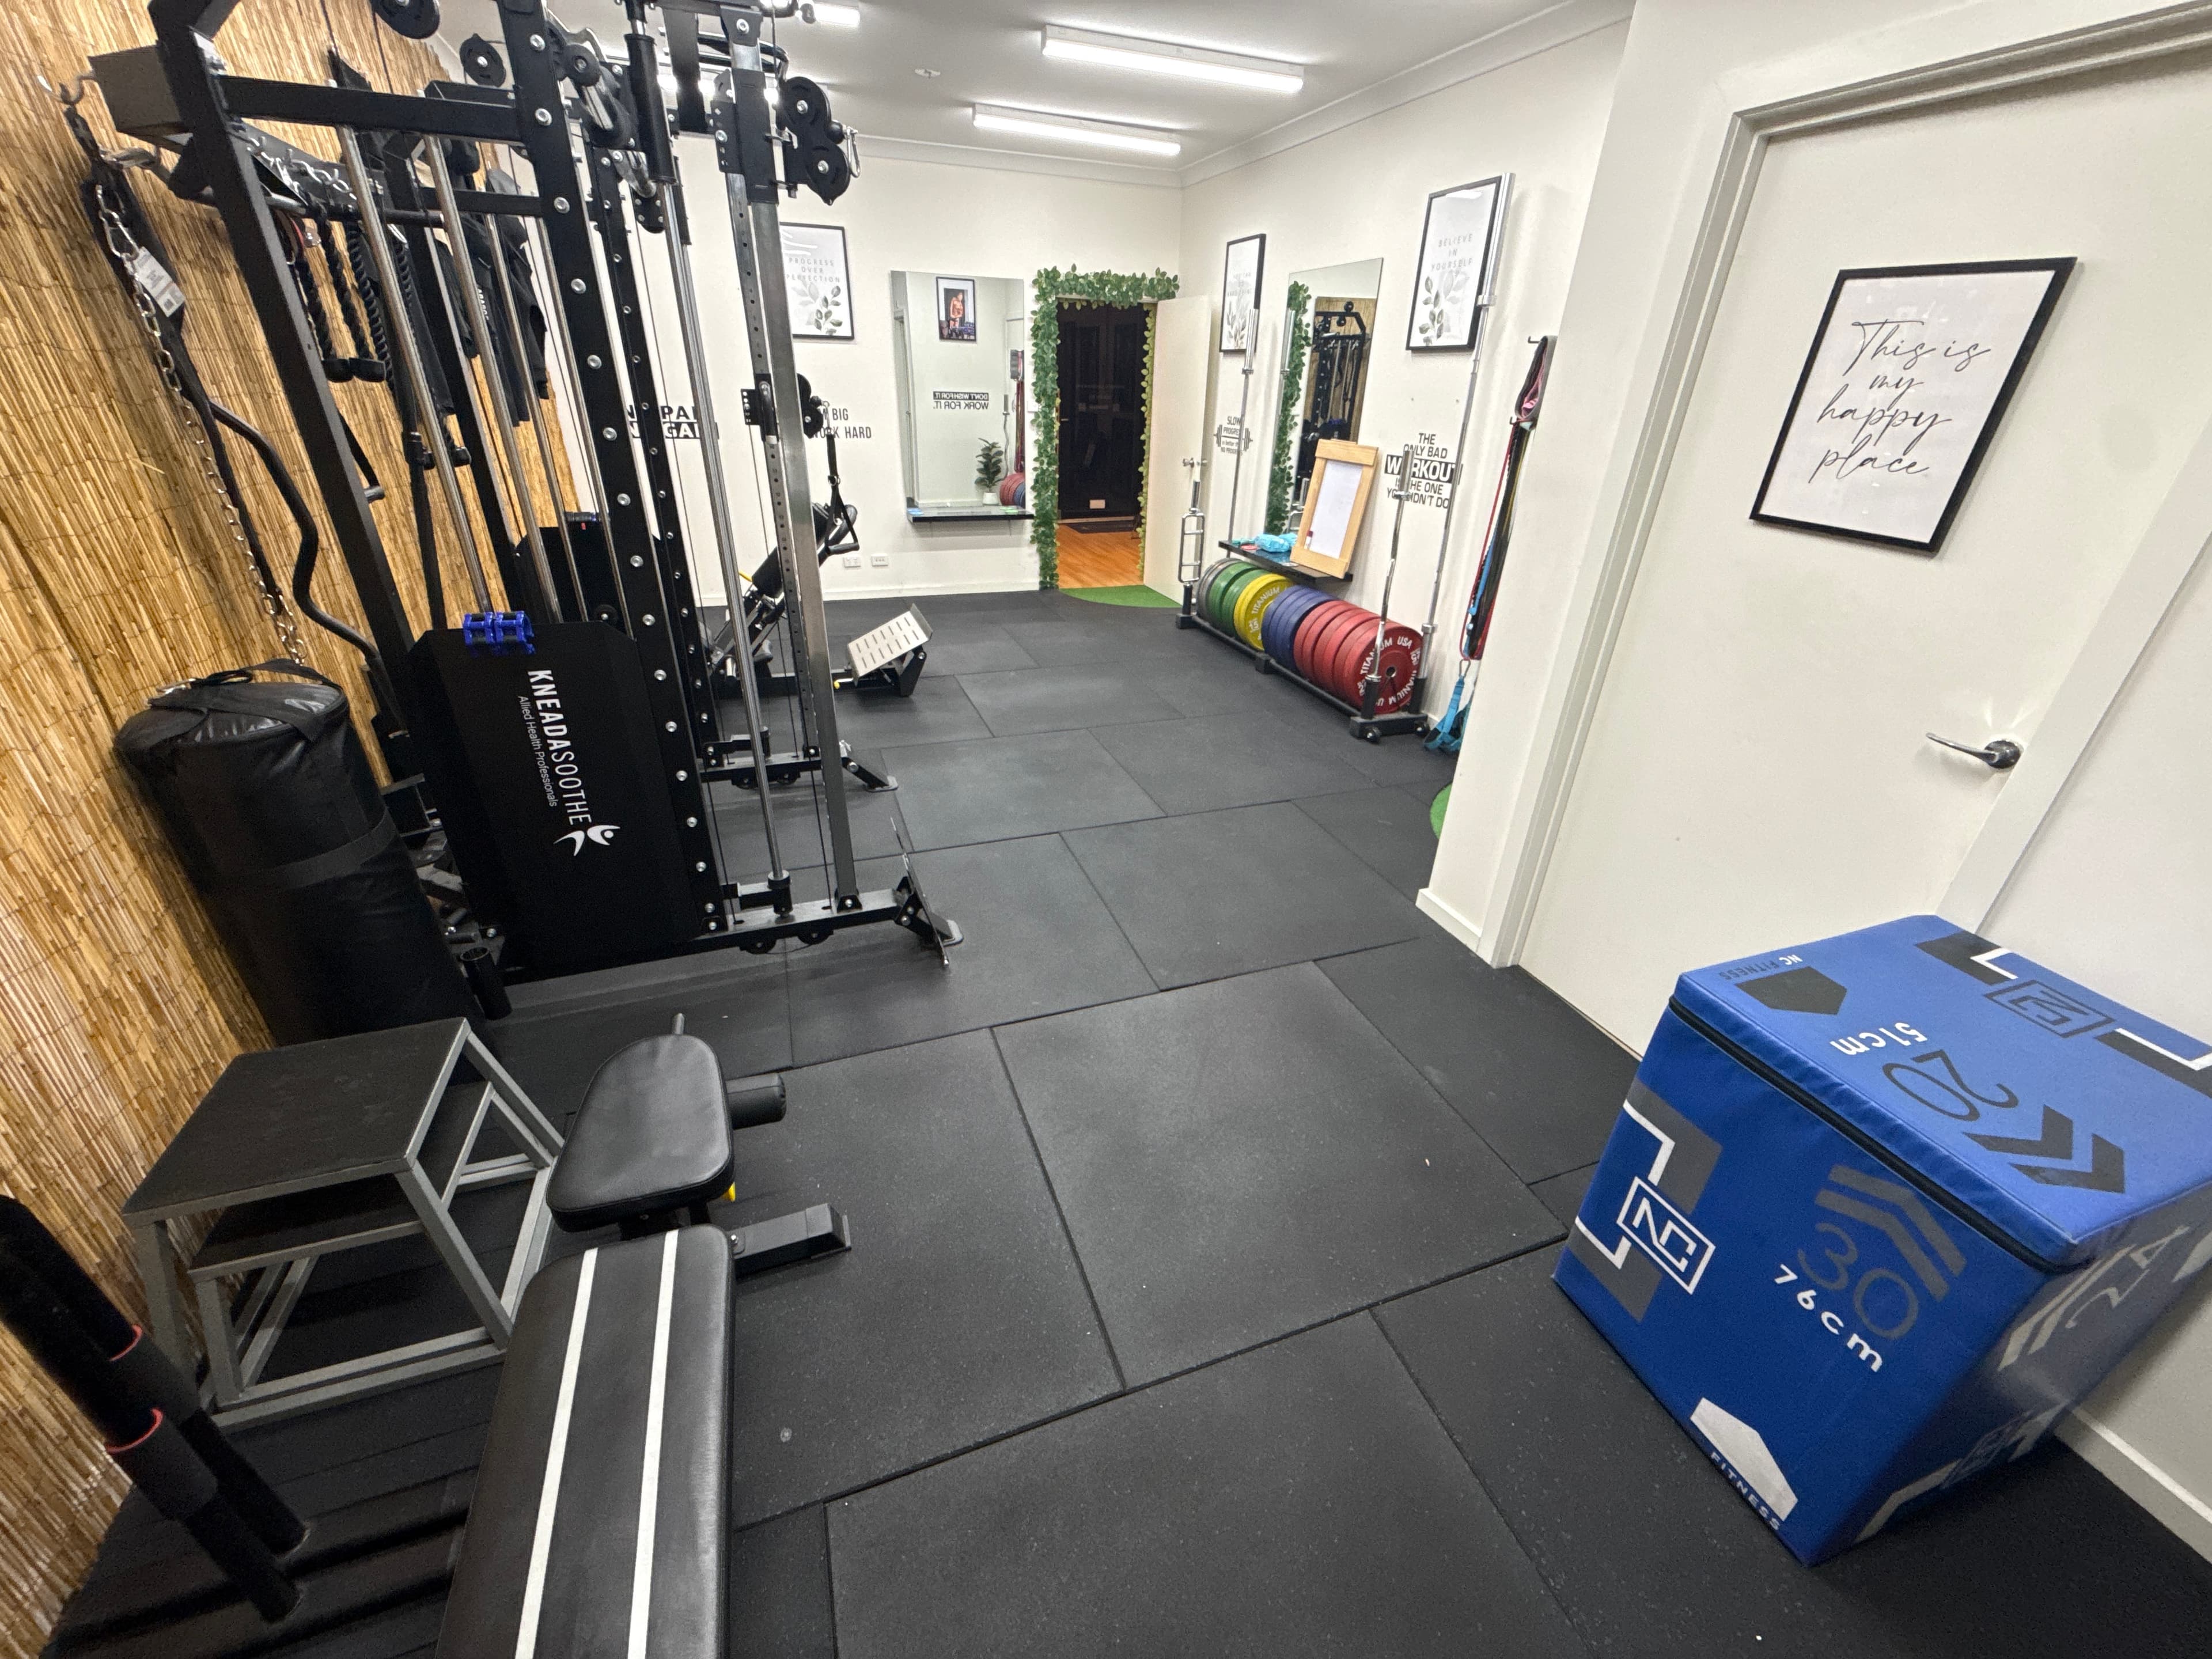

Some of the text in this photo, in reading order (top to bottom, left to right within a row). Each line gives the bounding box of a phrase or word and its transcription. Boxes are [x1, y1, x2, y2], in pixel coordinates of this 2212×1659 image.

[789, 257, 834, 266] PROGRESS
[1431, 258, 1473, 271] YOURSELF
[1842, 319, 1991, 377] This is
[1869, 374, 1924, 411] my
[661, 406, 697, 420] PAI
[832, 408, 849, 421] BIG
[1227, 415, 1240, 426] SLOW
[1816, 383, 1952, 457] happy
[664, 423, 700, 438] GAI
[844, 426, 872, 438] HARD
[1419, 433, 1436, 445] THE
[1427, 446, 1448, 459] BAD
[1808, 433, 1930, 483] place
[1387, 456, 1456, 482] WRKOU
[1410, 480, 1422, 491] HE
[1424, 482, 1444, 495] ONE
[1435, 497, 1449, 509] DO
[1252, 586, 1280, 614] TITANIUM
[1397, 636, 1412, 649] USA
[518, 695, 558, 807] Allied Health Professionals
[527, 669, 592, 825] KNEADASOOTHE
[1719, 954, 1804, 981] NC FITNESS
[1830, 1022, 1928, 1055] 51cm
[1882, 1048, 2020, 1122] 20
[1797, 1222, 1919, 1340] 30
[1774, 1264, 1884, 1373] 76cm
[1710, 1451, 1781, 1531] FITNESS
